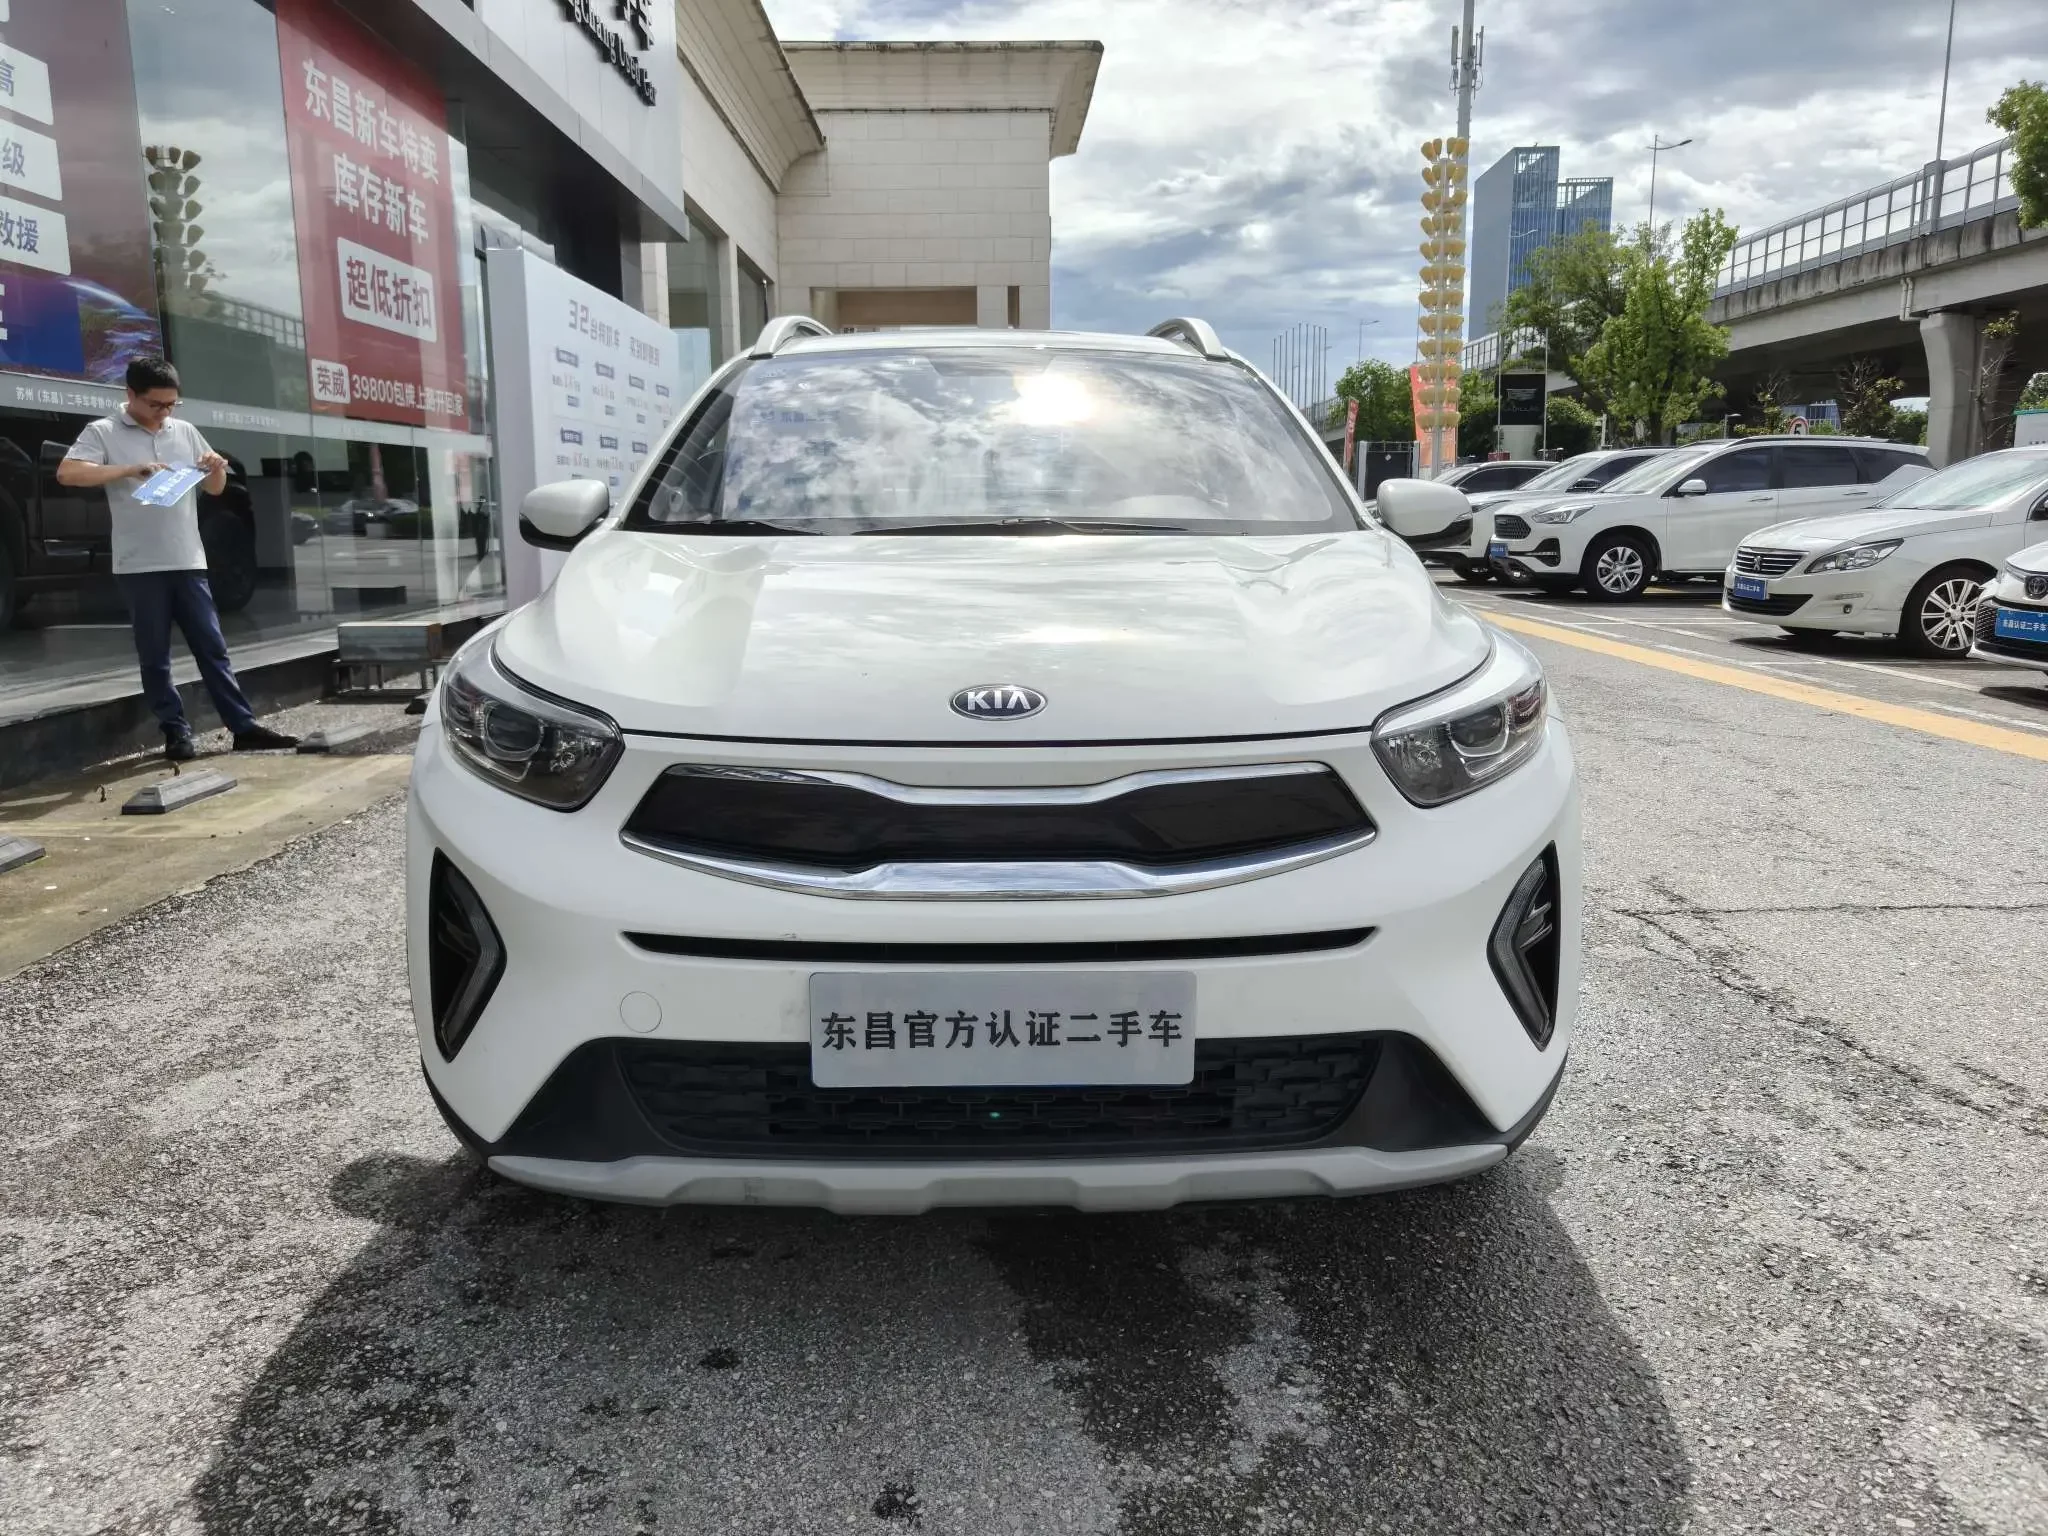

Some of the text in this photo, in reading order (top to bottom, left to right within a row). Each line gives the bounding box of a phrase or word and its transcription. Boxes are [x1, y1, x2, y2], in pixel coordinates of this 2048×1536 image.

[569, 0, 617, 64] gChang
[302, 58, 439, 185] 东昌新车特卖
[333, 153, 429, 245] 库存新车
[346, 256, 432, 328] 超低折扣
[316, 365, 347, 398] 荣威
[966, 688, 1032, 711] KIA
[821, 1009, 1184, 1051] 东昌官方认证二手车
